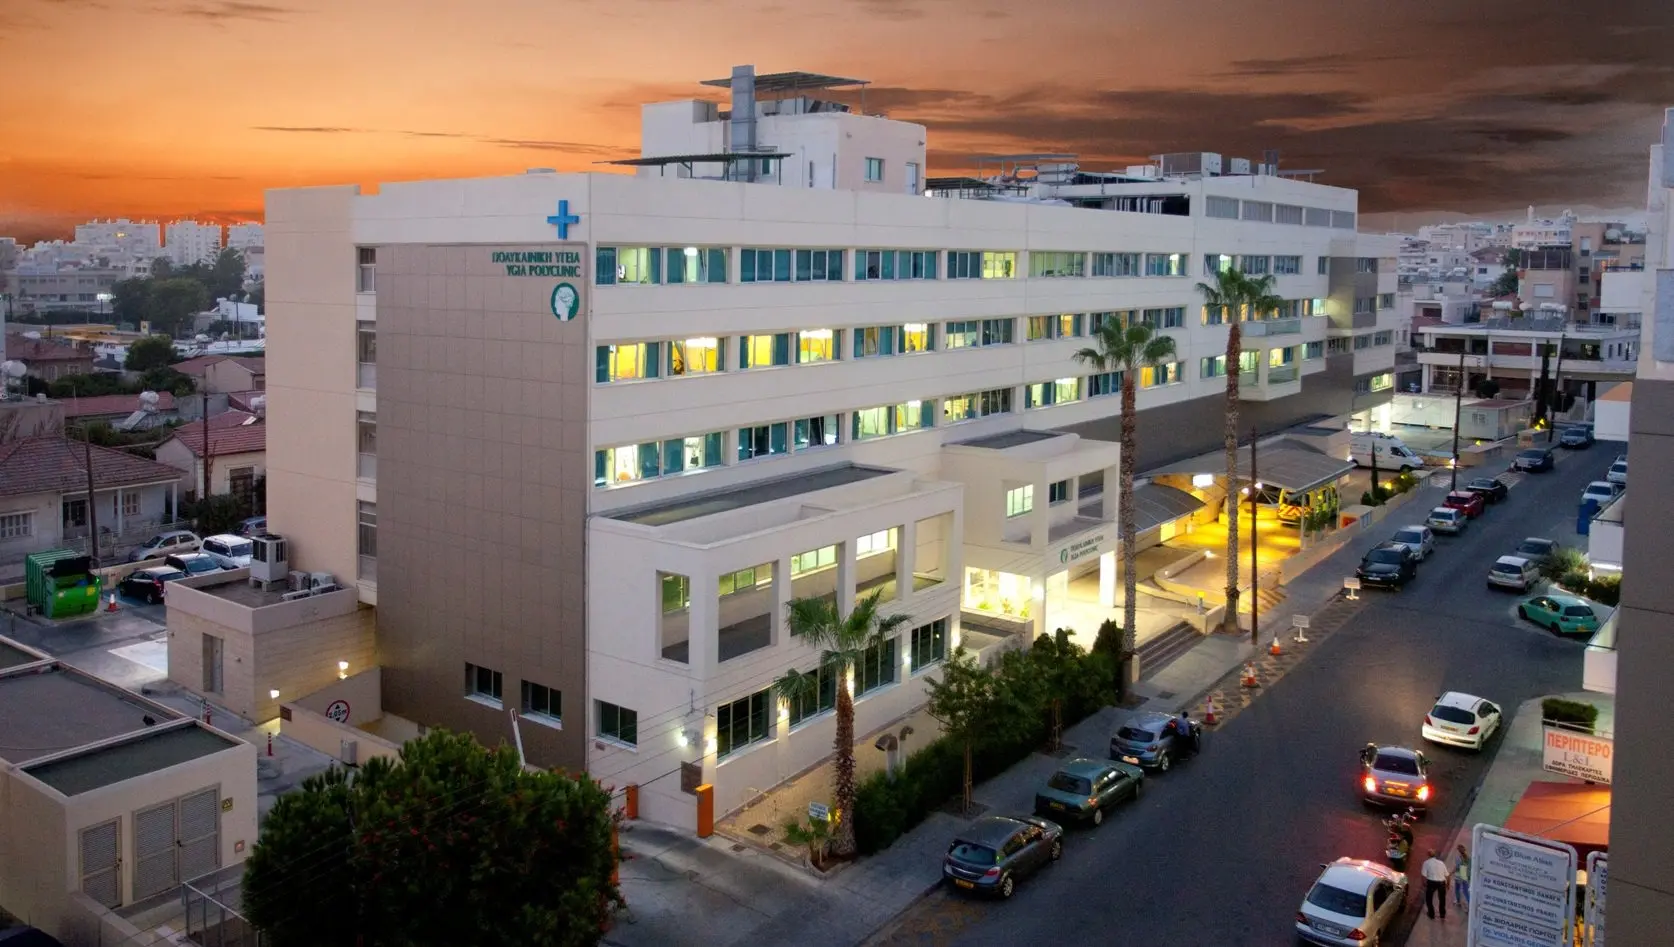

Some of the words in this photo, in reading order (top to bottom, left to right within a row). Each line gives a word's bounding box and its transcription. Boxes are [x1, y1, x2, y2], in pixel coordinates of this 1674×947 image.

[506, 265, 527, 276] YGIA
[529, 265, 581, 277] POLYCLINIC
[1547, 732, 1610, 758] ΠΕΡΙΠΤΕΡΟ
